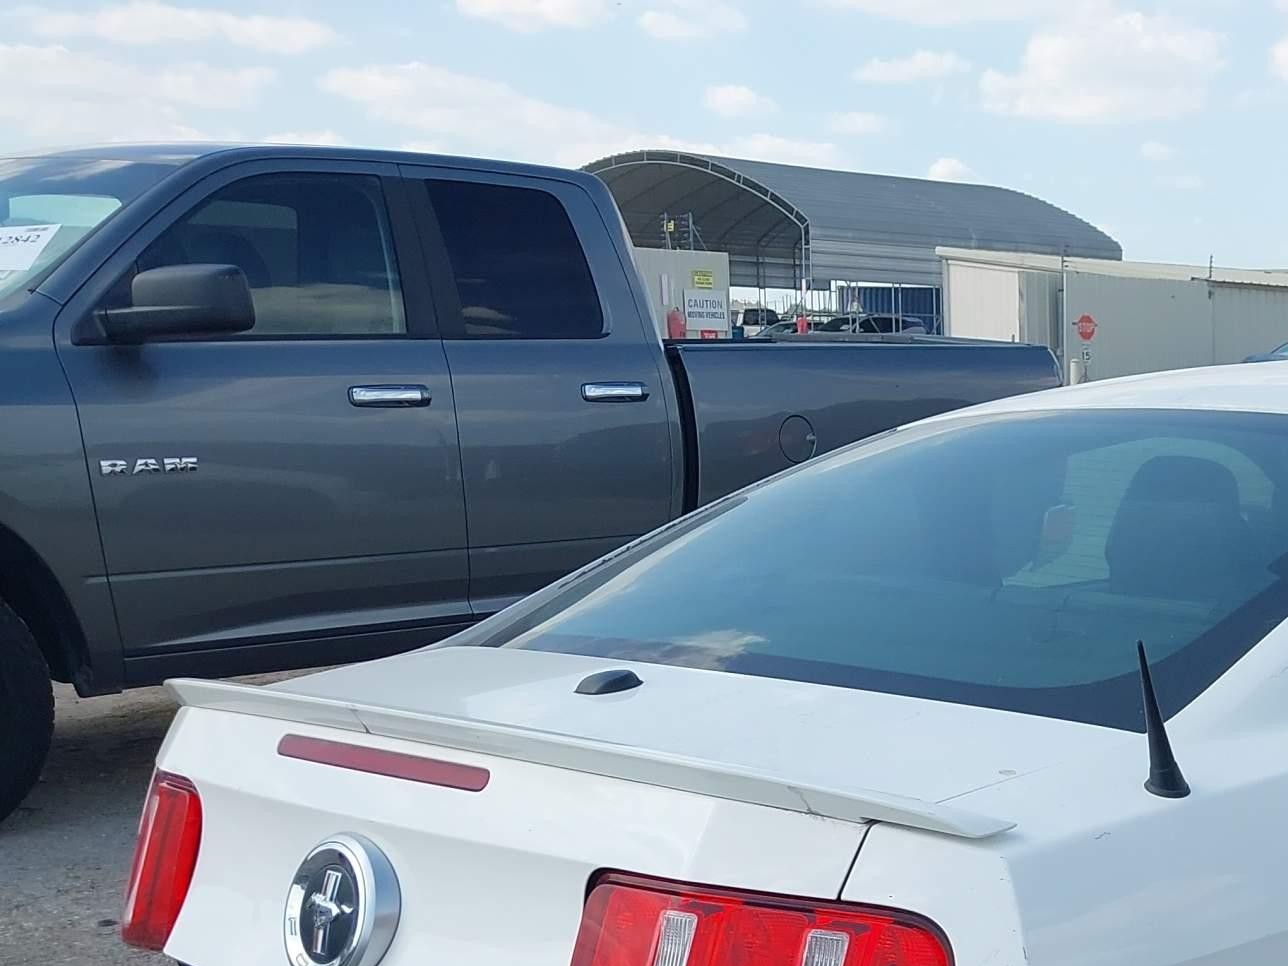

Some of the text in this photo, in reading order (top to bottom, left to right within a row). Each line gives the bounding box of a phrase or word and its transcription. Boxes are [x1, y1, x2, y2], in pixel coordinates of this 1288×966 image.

[688, 298, 723, 309] CAUTION
[688, 311, 725, 320] MOVING VEHICLES
[1079, 321, 1095, 332] STOP
[1082, 351, 1091, 360] 15
[100, 457, 199, 475] RAM
